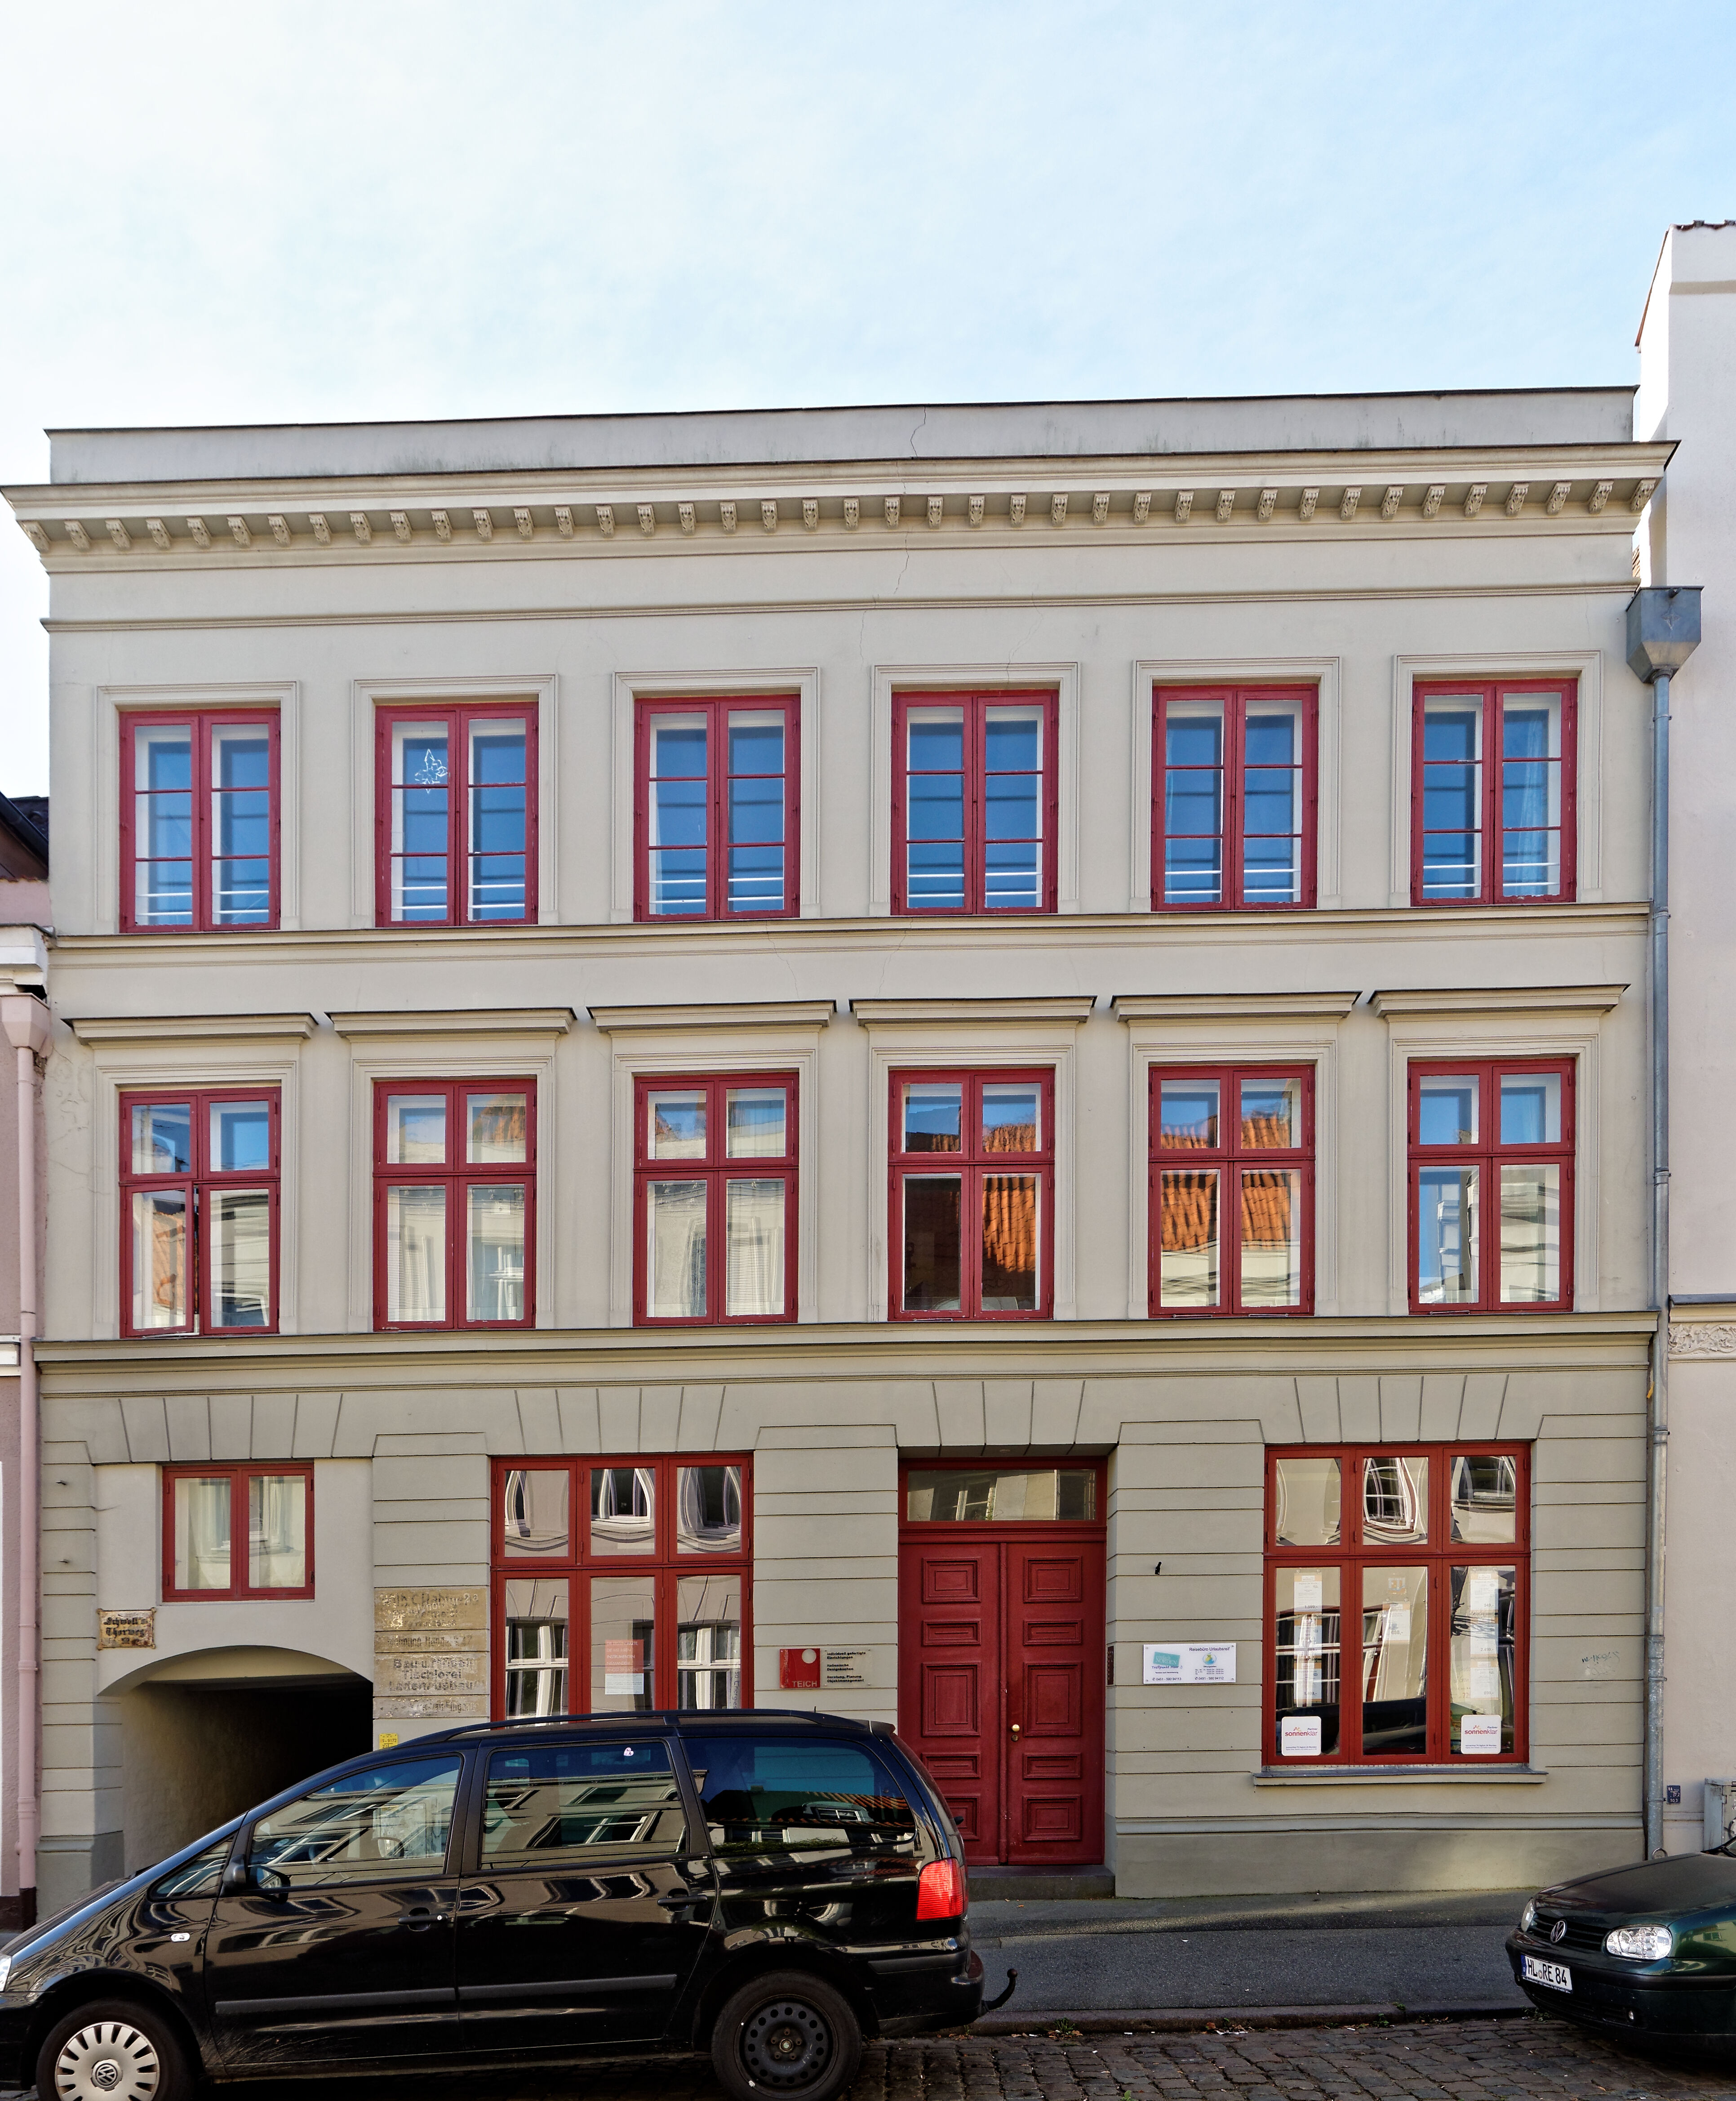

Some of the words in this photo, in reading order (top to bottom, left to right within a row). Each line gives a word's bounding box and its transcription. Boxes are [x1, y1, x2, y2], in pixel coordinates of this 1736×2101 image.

[1155, 1657, 1177, 1665] NORDEN
[1527, 1958, 1538, 1977] HL
[1542, 1963, 1554, 1982] RE
[1555, 1967, 1567, 1986] 84
